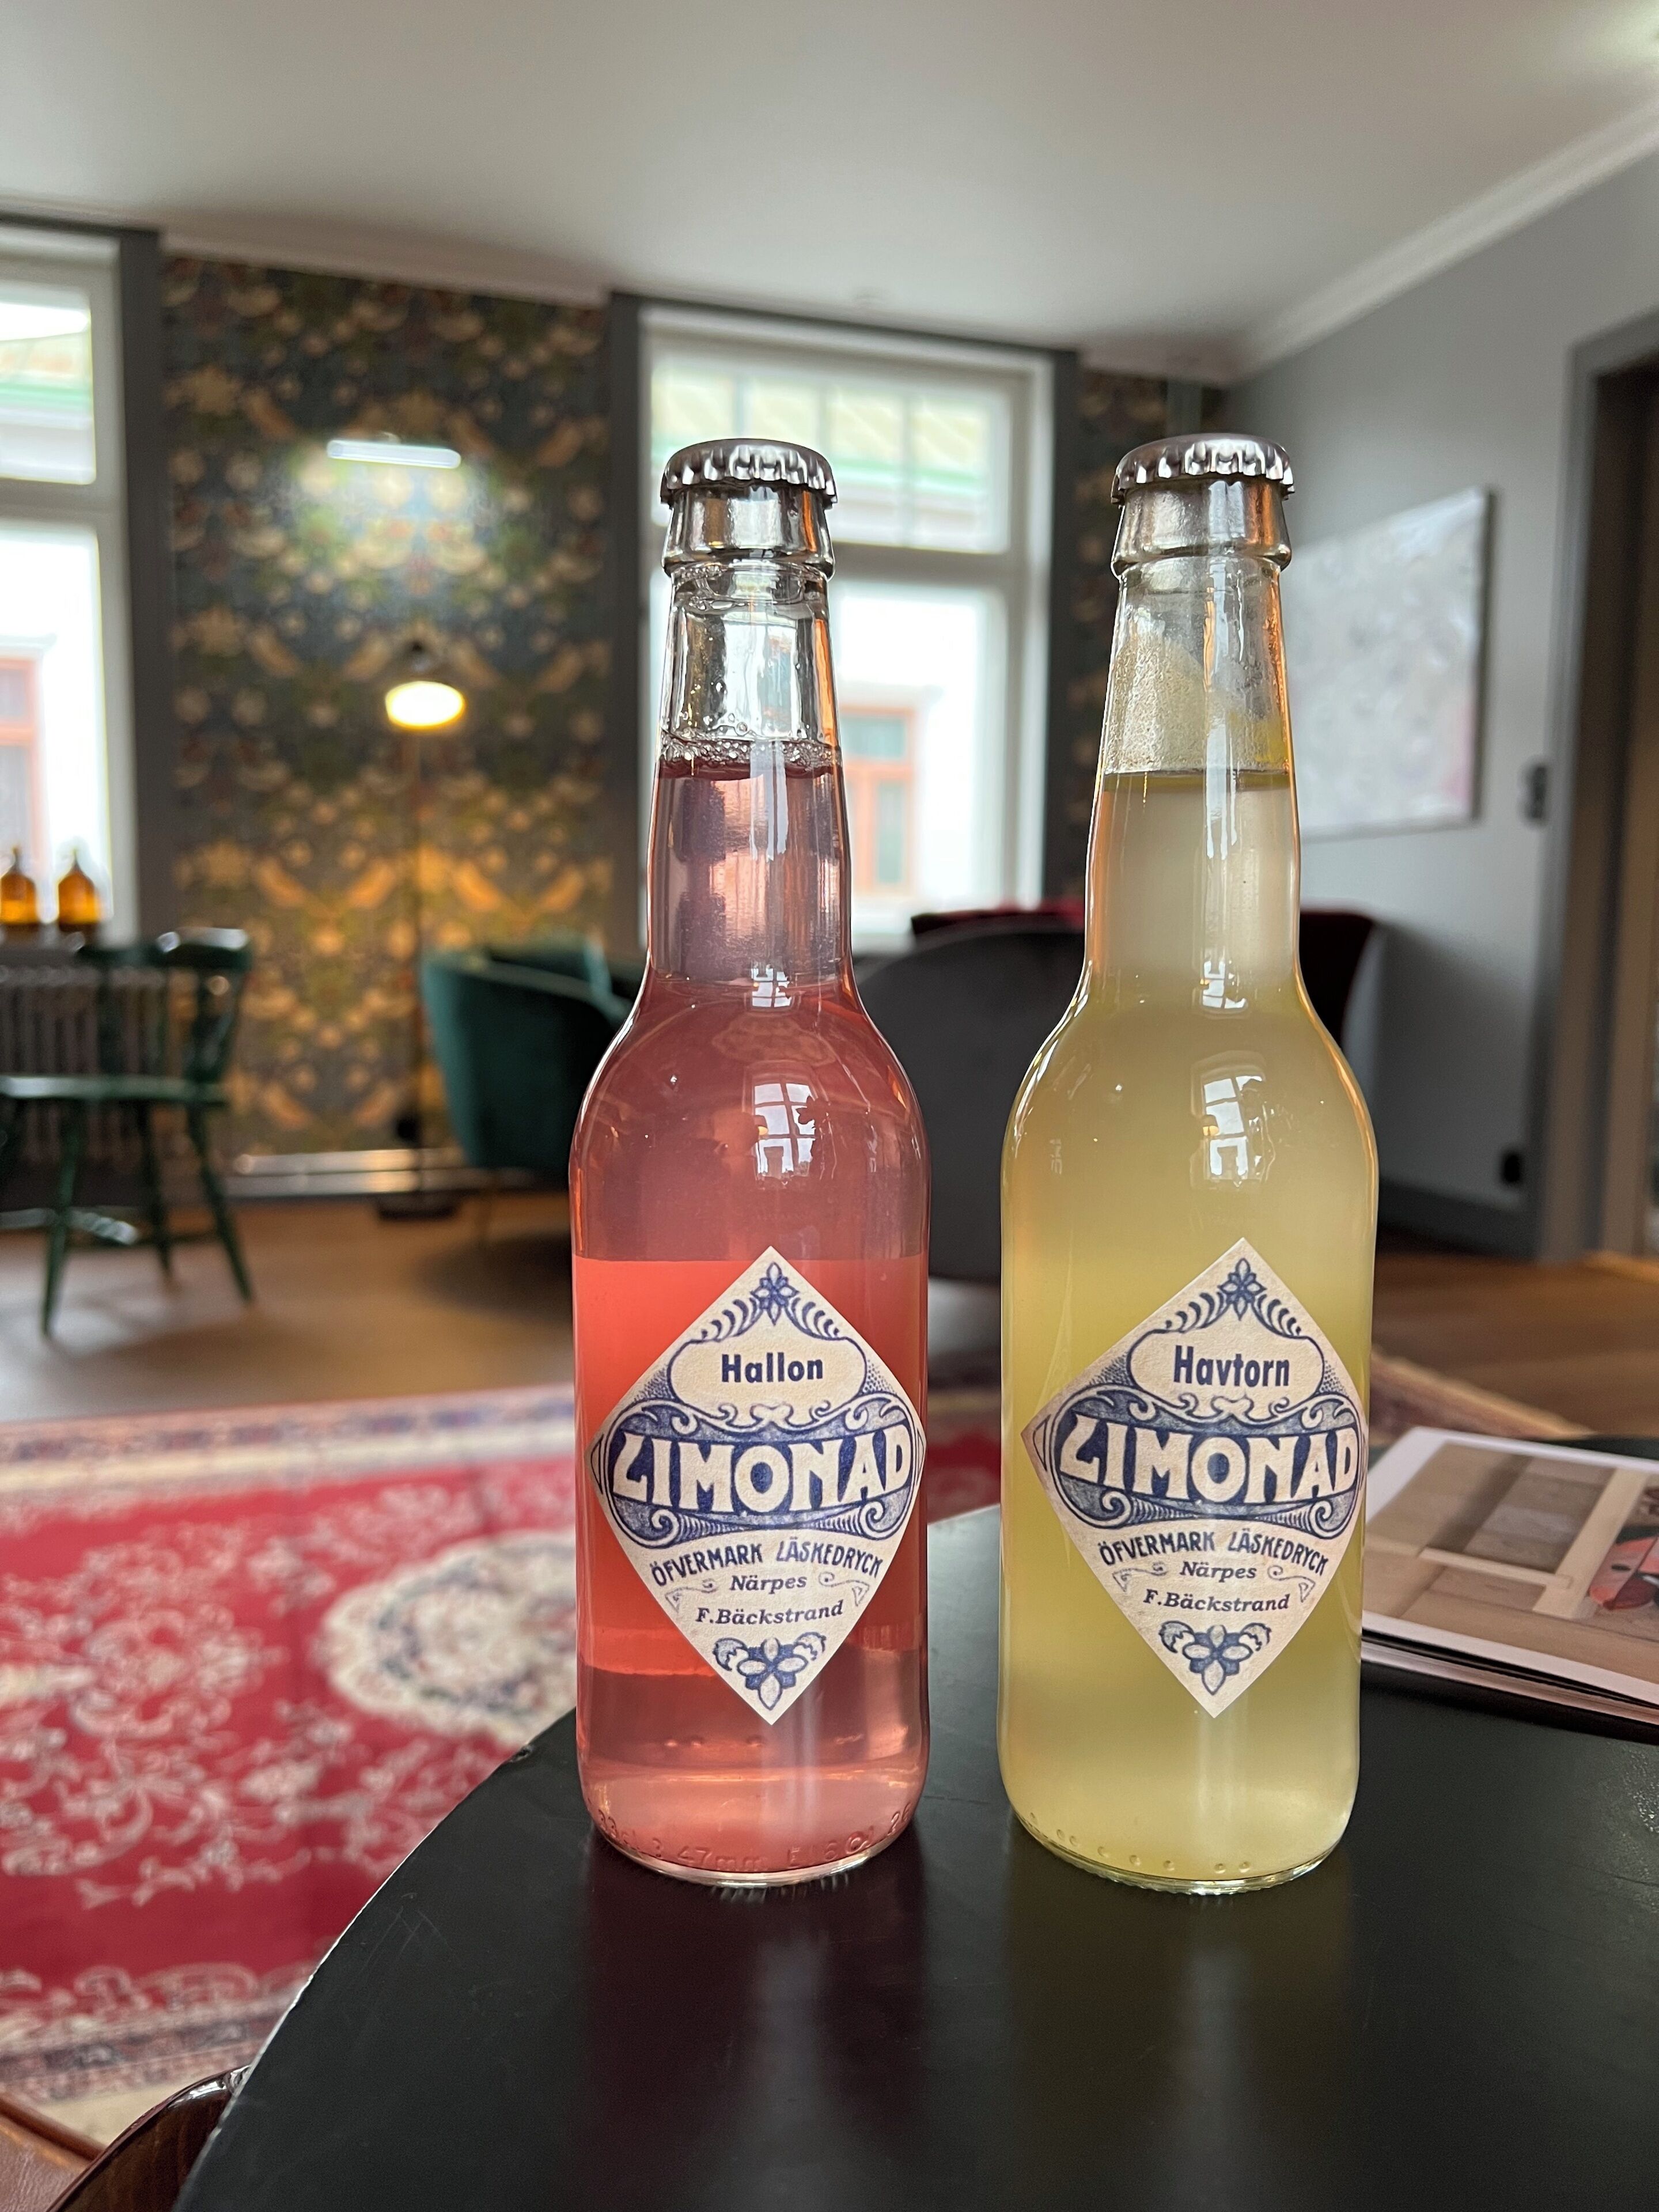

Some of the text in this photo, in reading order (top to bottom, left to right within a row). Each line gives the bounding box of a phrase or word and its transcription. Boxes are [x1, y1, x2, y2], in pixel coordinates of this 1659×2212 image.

[721, 1351, 824, 1383] Hallon
[1173, 1344, 1291, 1387] Havtorn
[612, 1423, 912, 1513] LIMONAD
[1059, 1412, 1358, 1503] LIMONAD
[650, 1537, 884, 1587] ÖFVERMARK LÄSKEDRYCK
[1099, 1529, 1330, 1577] ÖFVERMARK LÄSKEDRYCK
[729, 1574, 808, 1594] Närpes
[1179, 1561, 1257, 1583] Närpes
[695, 1600, 844, 1626] F.Bäckstrand
[1143, 1589, 1291, 1612] F.Bäckstrand
